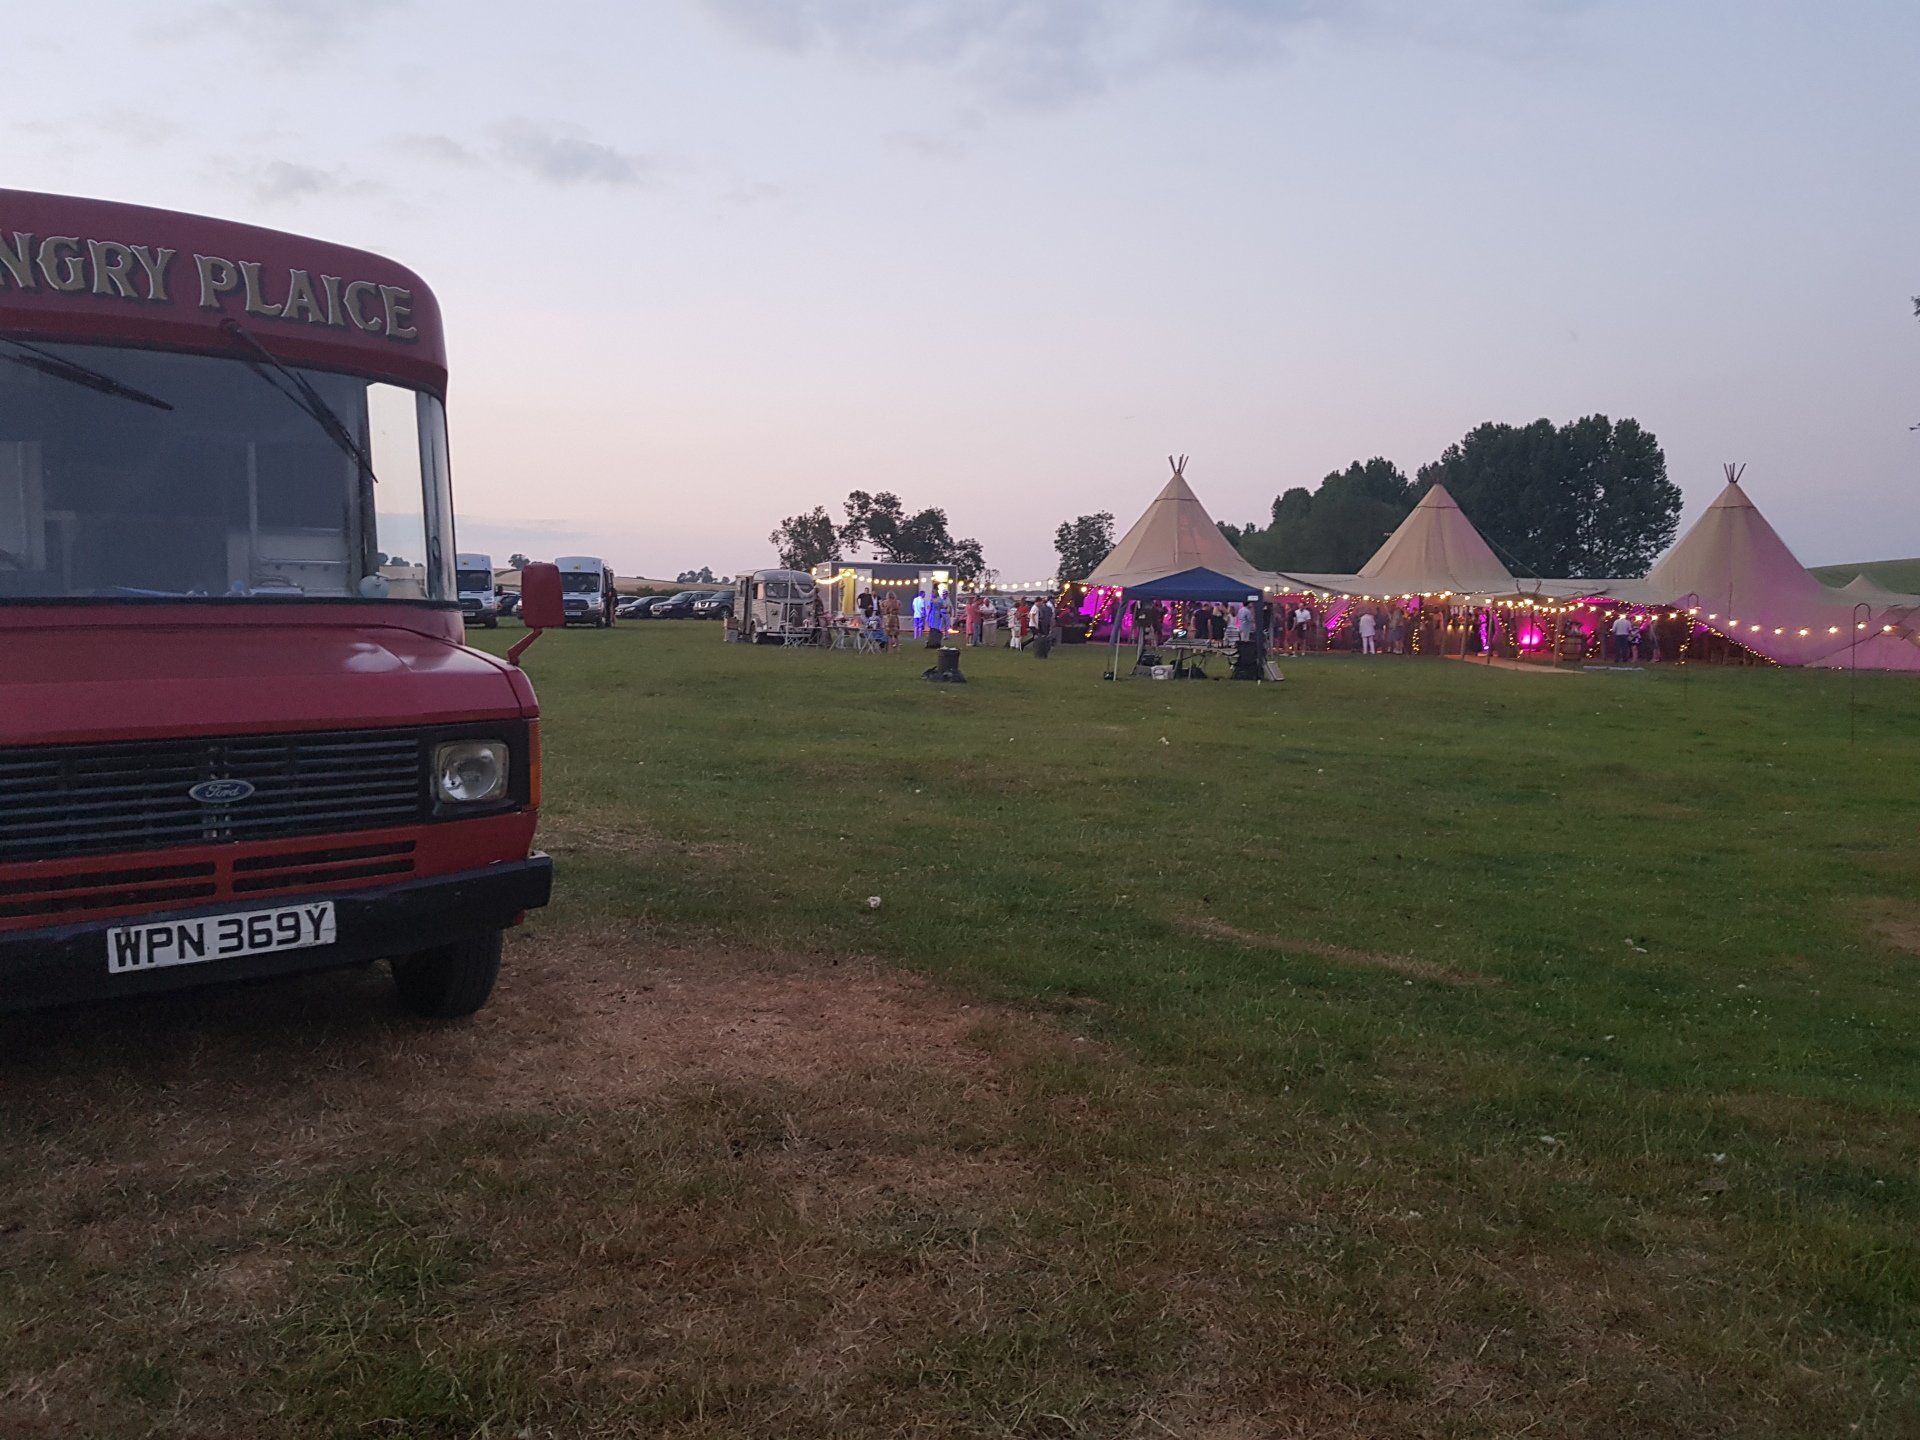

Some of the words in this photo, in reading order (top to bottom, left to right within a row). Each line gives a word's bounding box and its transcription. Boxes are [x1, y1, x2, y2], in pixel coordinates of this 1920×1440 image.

[194, 253, 417, 339] PLAICE
[205, 784, 240, 798] Ford
[114, 923, 205, 967] WPN
[217, 907, 328, 954] 369Y
